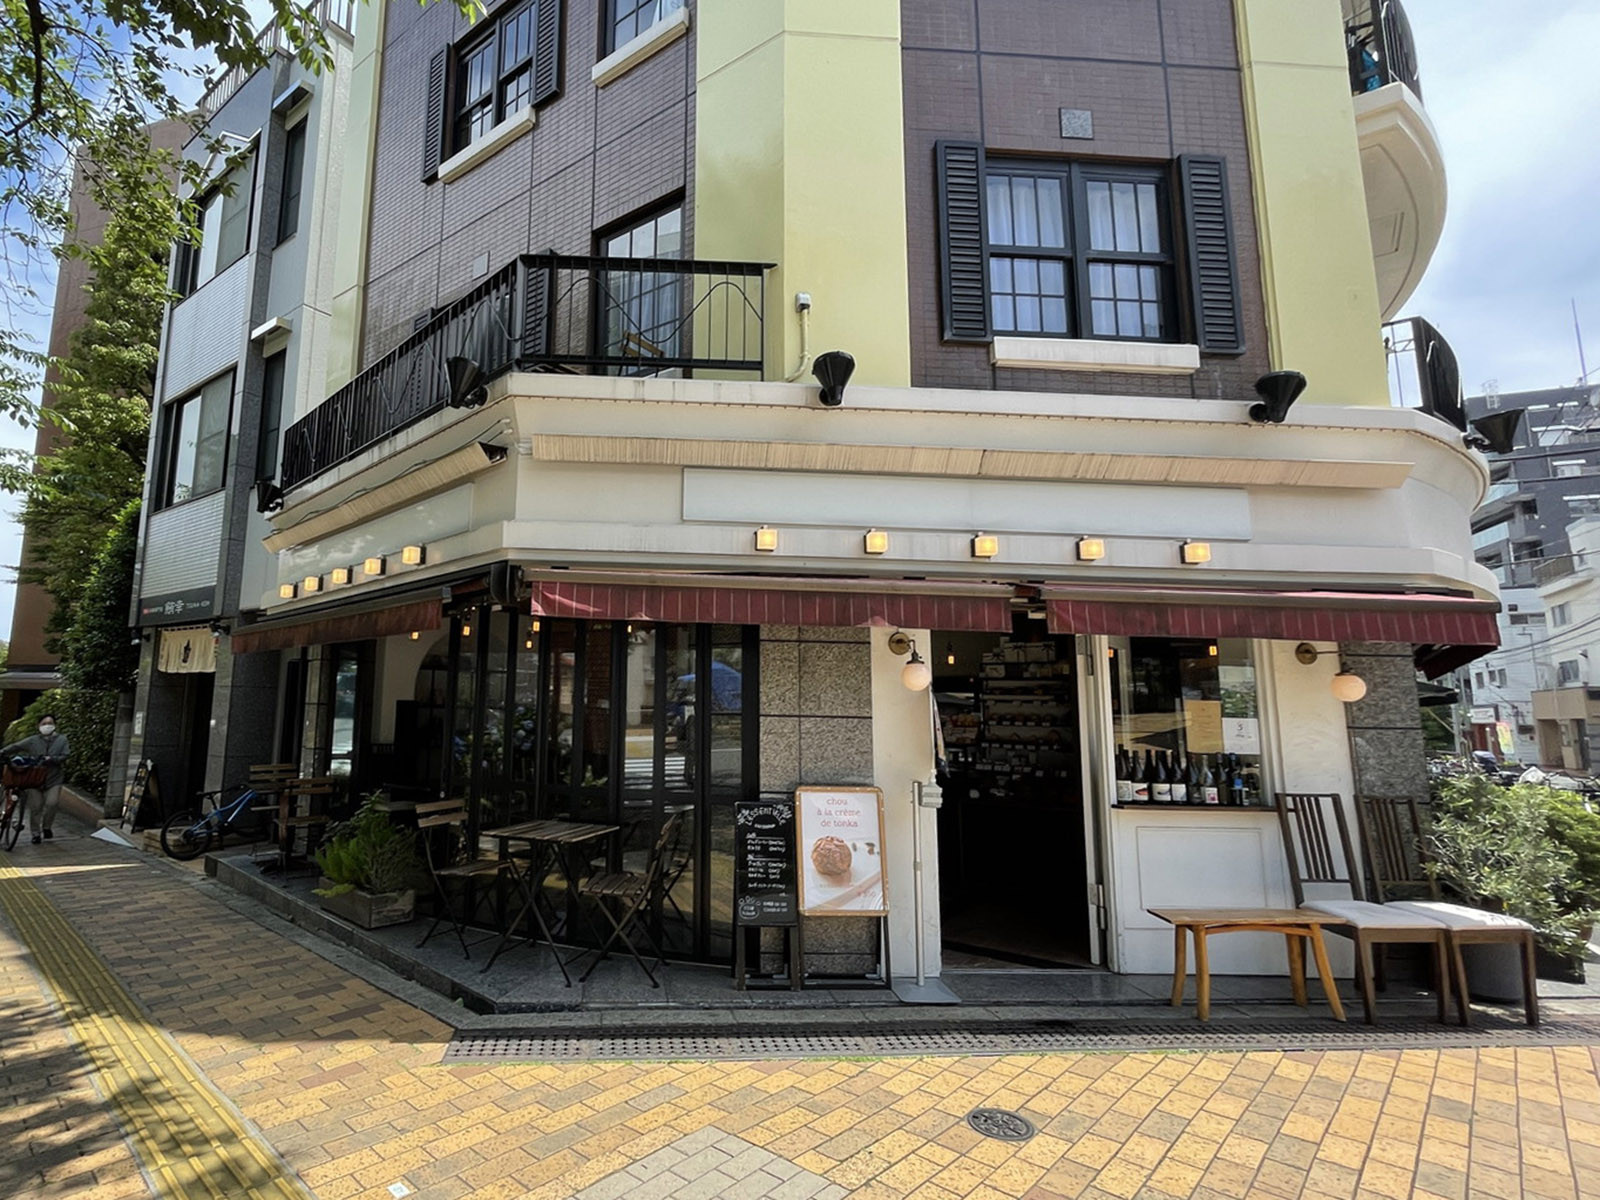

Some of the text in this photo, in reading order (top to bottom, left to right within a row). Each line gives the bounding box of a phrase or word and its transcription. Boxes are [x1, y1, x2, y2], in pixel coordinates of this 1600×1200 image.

[826, 797, 848, 806] chou
[824, 808, 833, 816] la
[820, 818, 858, 828] de tonka
